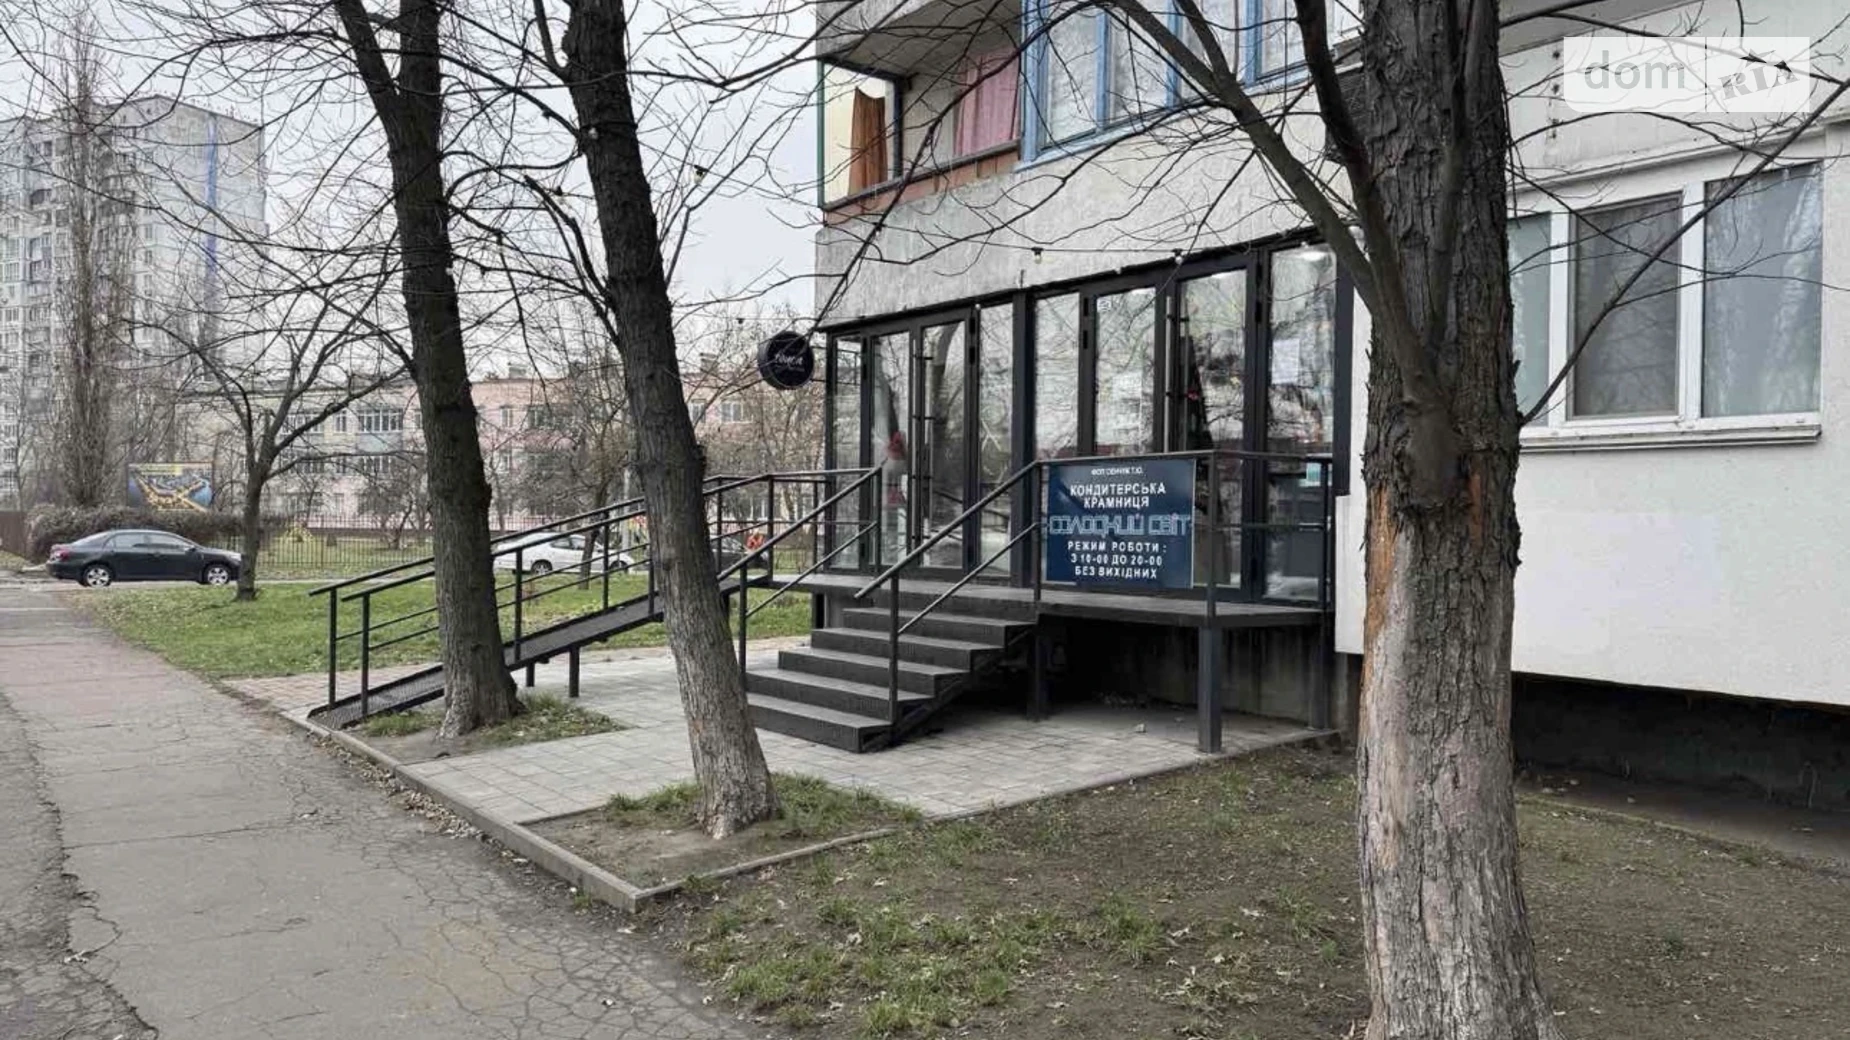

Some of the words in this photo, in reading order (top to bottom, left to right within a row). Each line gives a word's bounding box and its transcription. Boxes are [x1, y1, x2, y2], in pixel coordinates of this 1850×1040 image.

[1070, 482, 1166, 497] КОНДИТЕРСЬКА
[1083, 495, 1150, 510] КРАМНИЦЯ
[1067, 541, 1106, 551] РЕЖИМ
[1080, 553, 1109, 564] 10-00
[1111, 555, 1127, 566] ДО
[1130, 555, 1163, 566] 20-00
[1074, 566, 1095, 576] БЕЗ
[1098, 566, 1157, 579] ВИХІДНИХ
